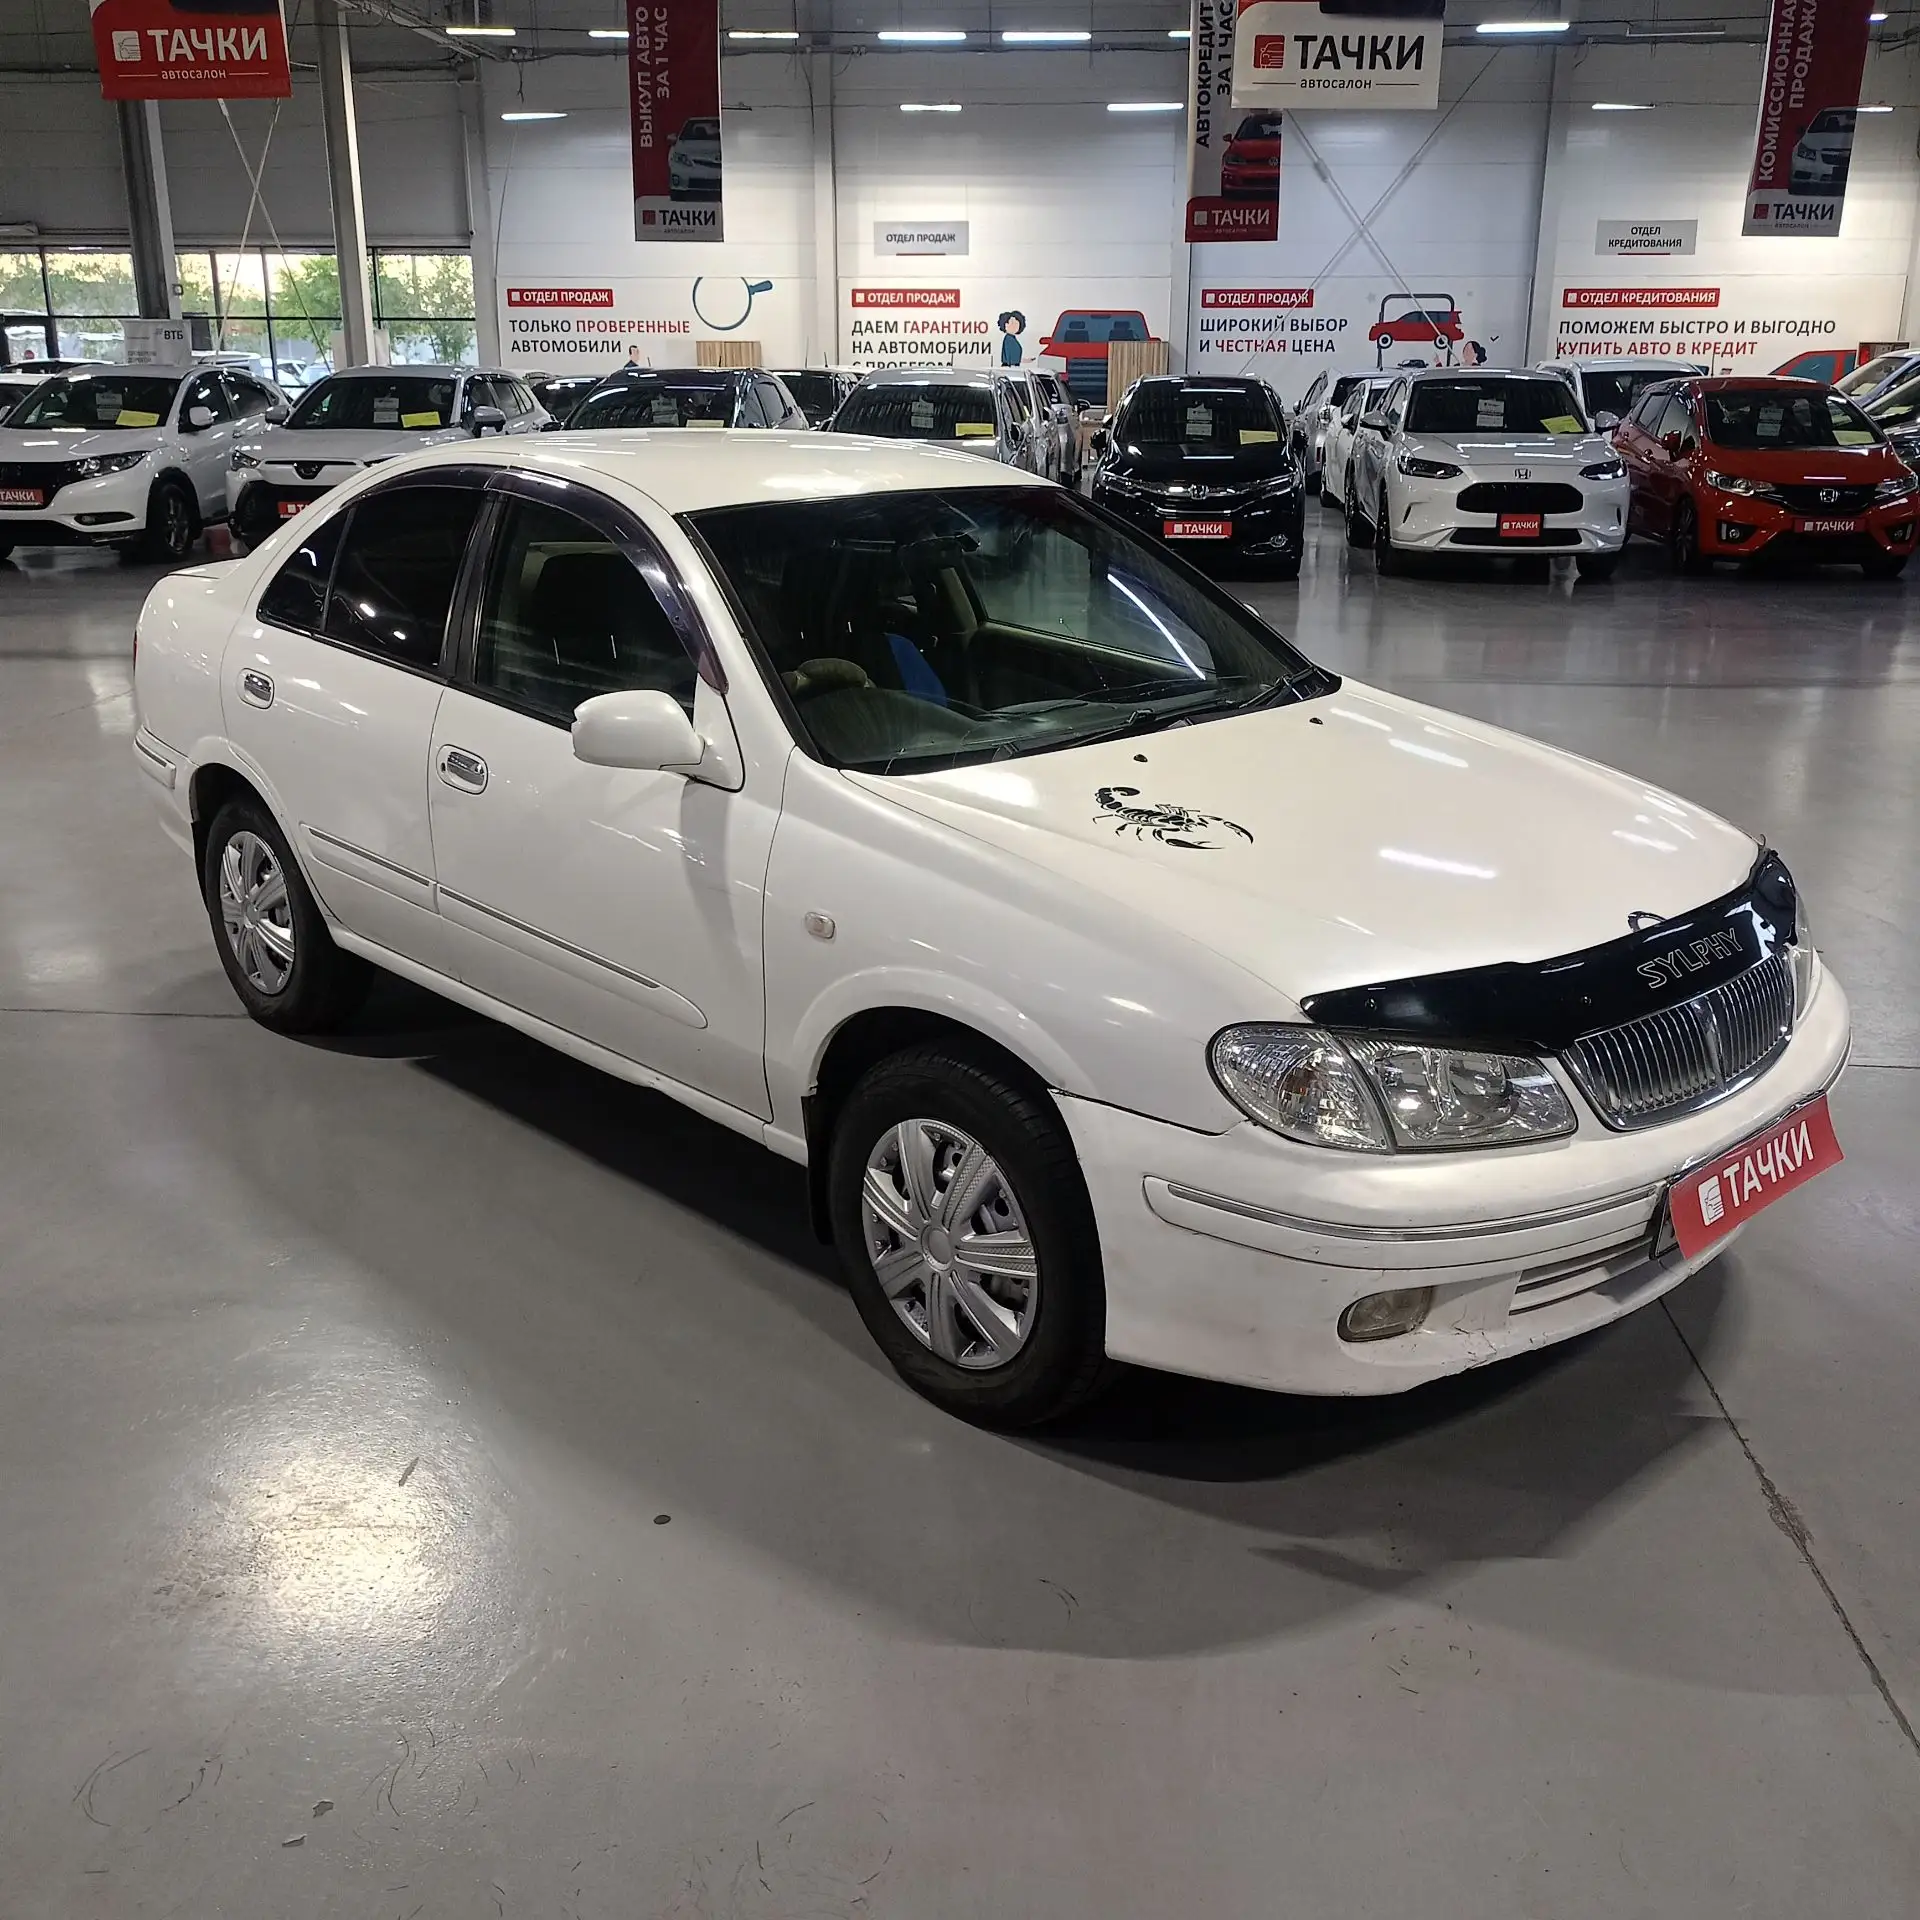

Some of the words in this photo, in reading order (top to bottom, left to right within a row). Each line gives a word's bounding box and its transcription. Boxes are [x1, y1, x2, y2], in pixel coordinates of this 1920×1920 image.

[654, 7, 669, 51] ЧАС
[1218, 1, 1234, 47] ЧАС
[635, 6, 651, 65] АВТО
[147, 27, 268, 62] ТАЧКИ
[1218, 53, 1232, 62] 1
[1293, 35, 1425, 70] ТАЧКИ
[655, 57, 669, 65] 1
[161, 69, 227, 80] автосалон
[1196, 2, 1216, 149] АВТОКРЕДИТ
[1217, 67, 1232, 96] ЗА
[656, 70, 670, 99] ЗА
[1300, 78, 1372, 89] автосалон
[637, 71, 653, 148] ВЫКУП
[658, 209, 716, 226] ТАЧКИ
[1211, 209, 1270, 226] ТАЧКИ
[1773, 203, 1835, 220] ТАЧКИ
[886, 234, 915, 244] ОТДЕЛ
[916, 234, 956, 244] ПРОДАЖ
[1630, 226, 1661, 237] ОТДЕЛ
[1608, 238, 1682, 250] КРЕДИТОВАНИЯ
[523, 291, 558, 303] ОТДЕЛ
[560, 291, 609, 303] ПРОДАЖ
[867, 293, 904, 305] ОТДЕЛ
[906, 293, 955, 305] ПРОДАЖ
[1218, 293, 1255, 305] ОТДЕЛ
[1258, 293, 1309, 305] ПРОДАЖ
[1580, 292, 1619, 305] ОТДЕЛ
[1621, 292, 1716, 304] КРЕДИТОВАНИЯ
[509, 320, 571, 333] ТОЛЬКО
[576, 320, 690, 334] ПРОВЕРЕННЫЕ
[852, 320, 899, 336] ДАЕМ
[904, 320, 989, 334] ГАРАНТИЮ
[1200, 315, 1284, 332] ШИРОКИЙ
[1290, 318, 1348, 332] ВЫБОР
[1559, 320, 1654, 334] ПОМОЖЕМ
[1659, 320, 1729, 334] БЫСТРО
[1733, 320, 1746, 334] И
[1750, 320, 1836, 337] ВЫГОДНО
[164, 330, 184, 340] ВТБ
[511, 340, 622, 353] АВТОМОБИЛИ
[852, 341, 874, 354] НА
[878, 341, 992, 354] АВТОМОБИЛИ
[1199, 340, 1210, 352] И
[1216, 339, 1287, 352] ЧЕСТНАЯ
[1292, 339, 1336, 355] ЦЕНА
[1557, 341, 1623, 355] КУПИТЬ
[1627, 341, 1672, 355] АВТО
[1675, 341, 1686, 355] В
[1691, 341, 1758, 358] КРЕДИТ
[0, 491, 35, 501] ТАЧКИ
[1184, 524, 1222, 534] ТАЧКИ
[1511, 521, 1538, 529] ТАЧКИ
[1815, 521, 1855, 531] ТАЧКИ
[1636, 927, 1744, 990] SYLPHY
[1723, 1120, 1814, 1208] ТАЧКИ
